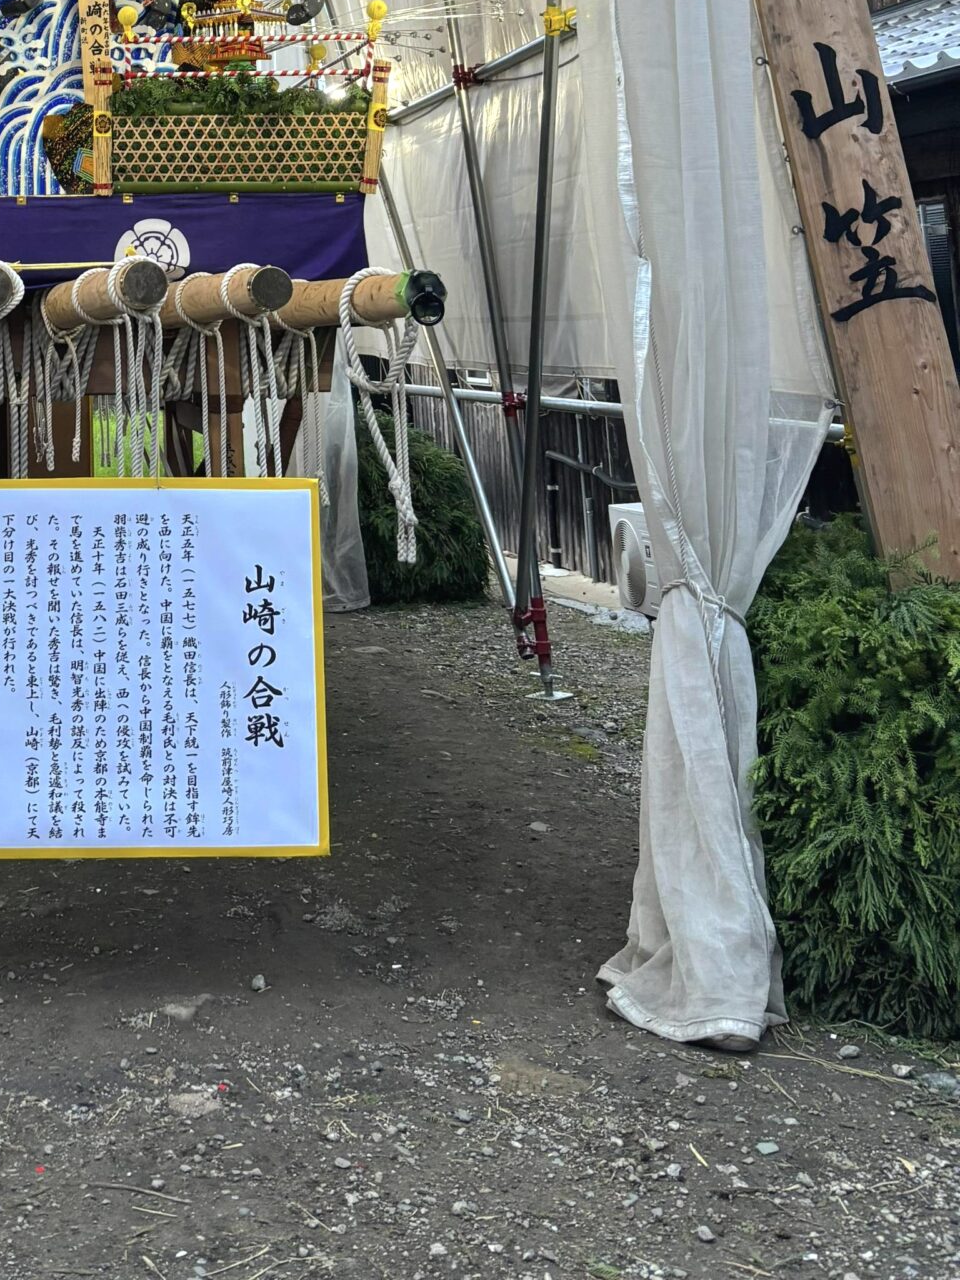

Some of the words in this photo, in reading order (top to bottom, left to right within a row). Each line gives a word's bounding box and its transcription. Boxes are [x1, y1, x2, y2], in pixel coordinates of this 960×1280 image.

[2, 514, 17, 693] 下分け目の一大決戦が行われた。
[242, 564, 284, 748] 山崎の合戦
